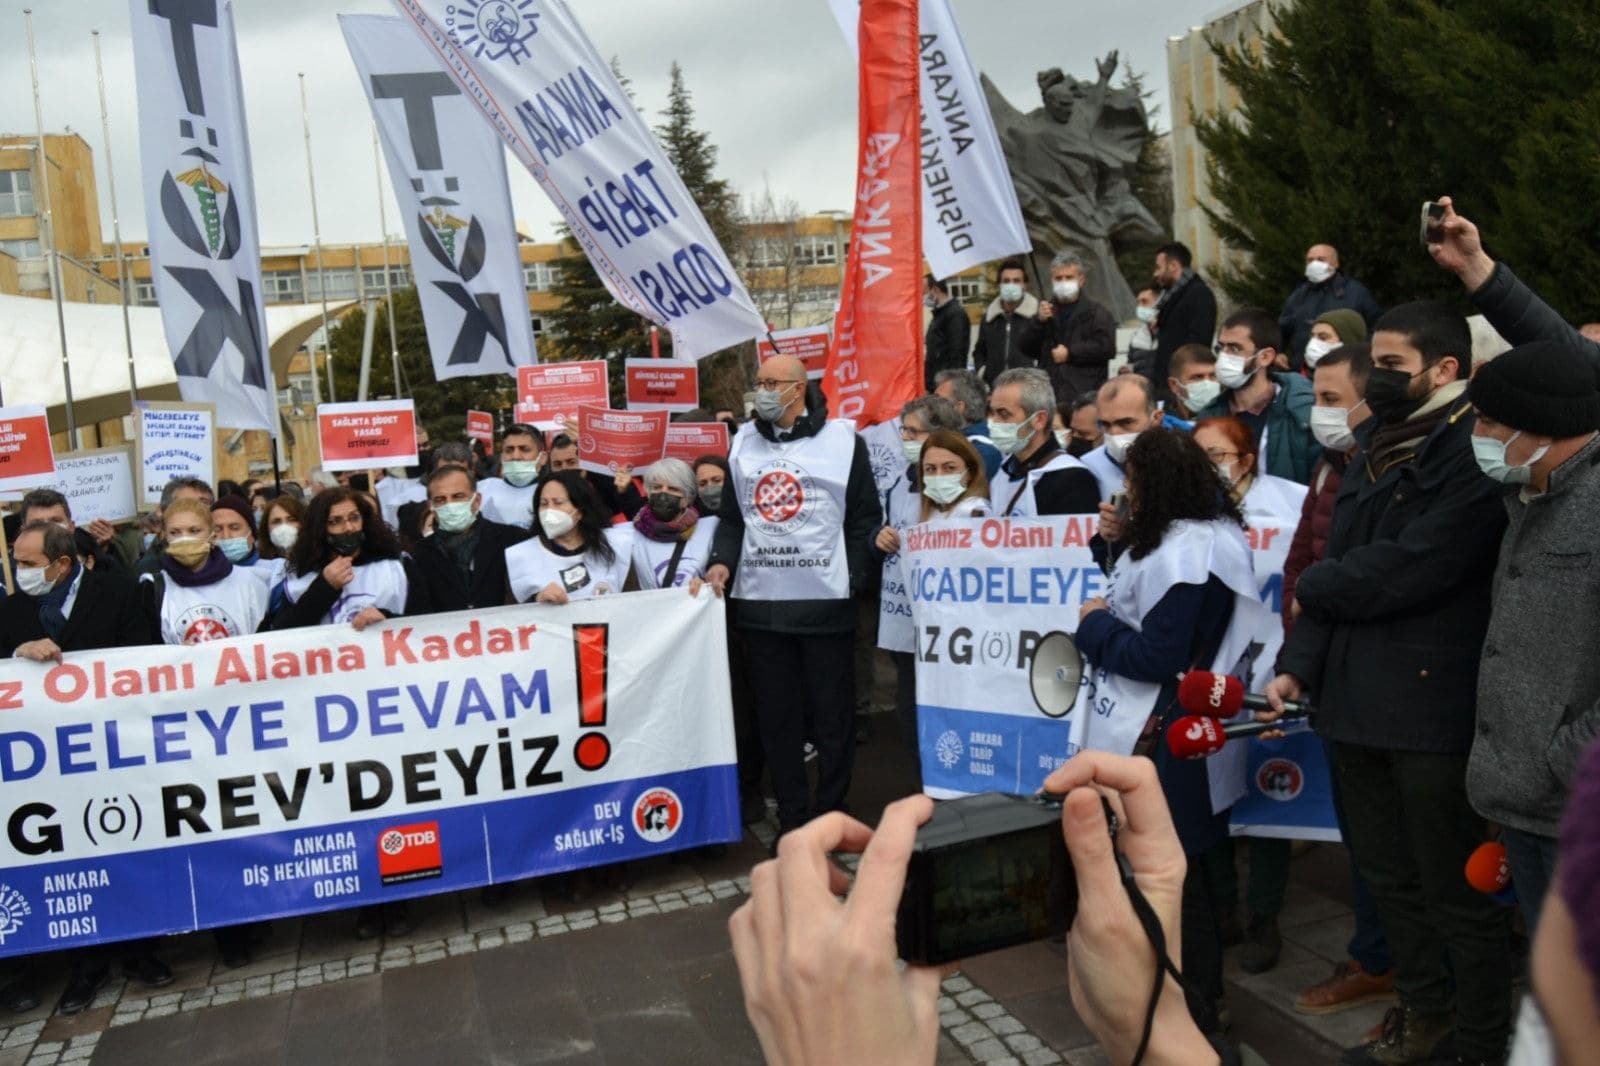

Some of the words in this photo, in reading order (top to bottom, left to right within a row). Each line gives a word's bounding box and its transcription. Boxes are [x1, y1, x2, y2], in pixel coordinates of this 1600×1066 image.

[980, 519, 1053, 549] Olanı
[757, 546, 800, 556] ANKARA
[798, 558, 830, 568] ODASI
[43, 661, 195, 704] Olanı
[215, 643, 366, 686] Alana
[383, 619, 537, 667] Kadar
[315, 669, 552, 744] DEVAM
[594, 801, 621, 820] DEV
[294, 831, 356, 856] ANKARA
[404, 830, 436, 847] TDB
[554, 822, 625, 852] SAĞLIK-İŞ
[243, 865, 269, 887] DİŞ
[274, 849, 358, 881] HEKİMLERİ
[44, 868, 110, 893] ANKARA
[314, 877, 360, 899] ODASI
[45, 893, 93, 917] TABİP
[48, 917, 97, 939] ODASI
